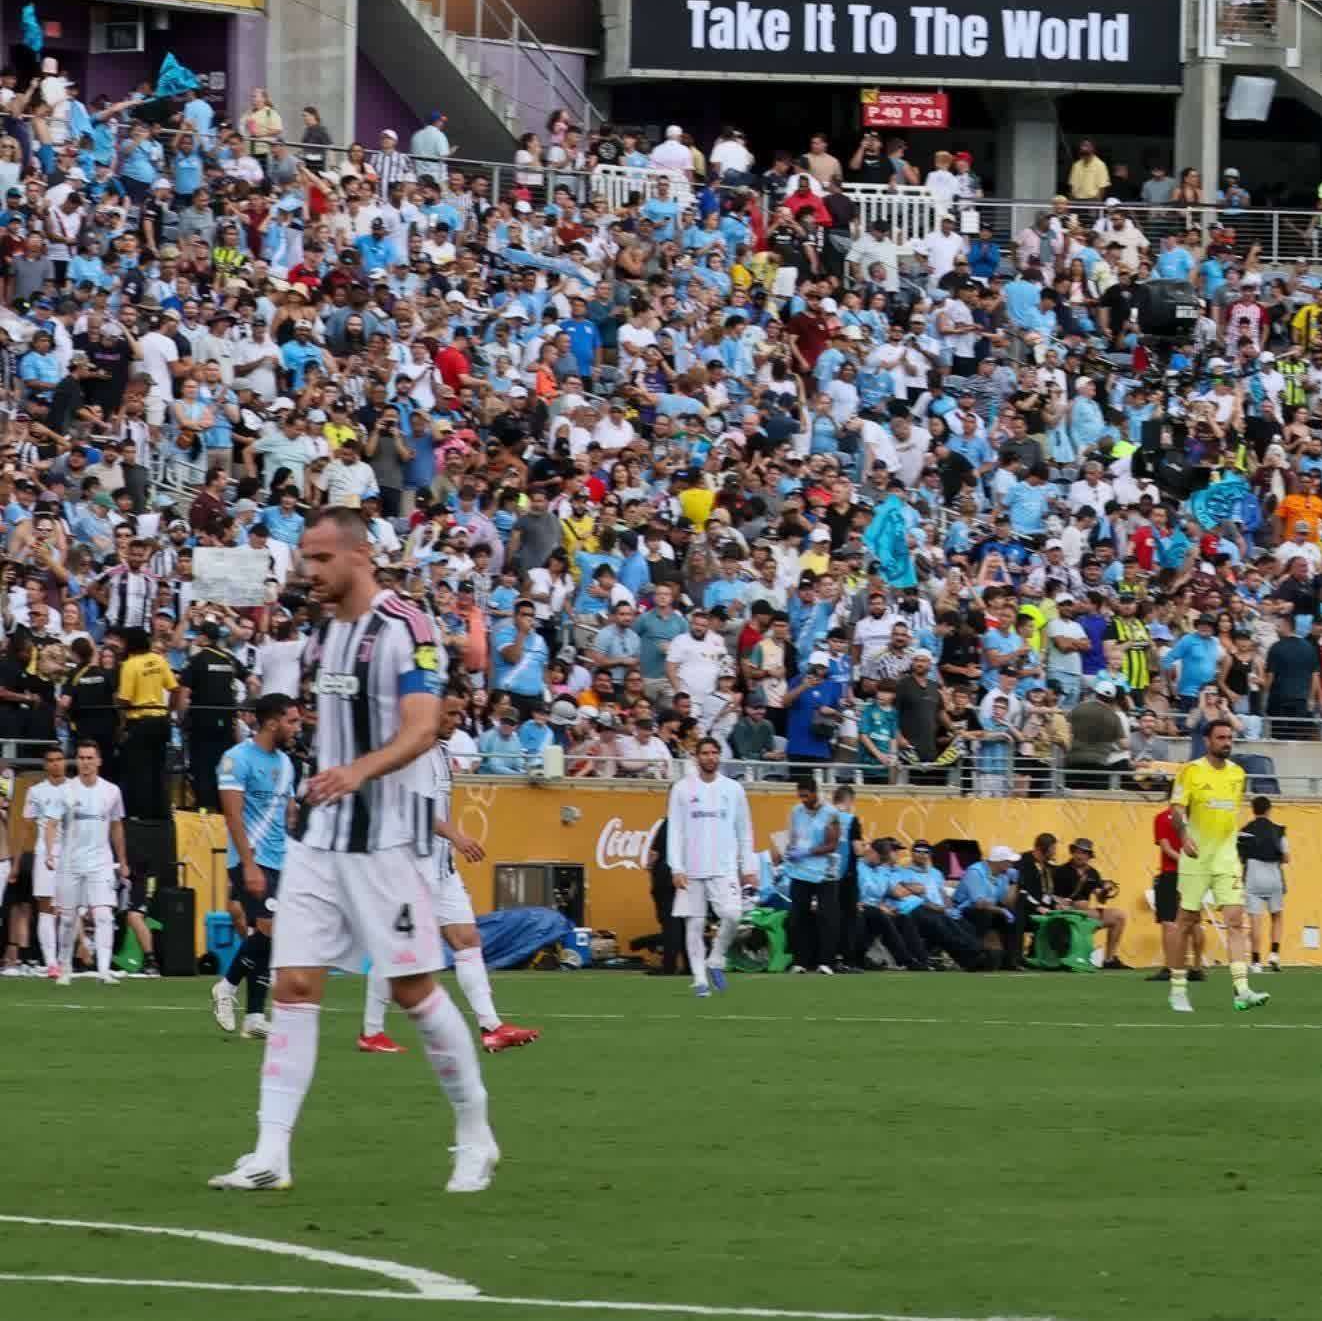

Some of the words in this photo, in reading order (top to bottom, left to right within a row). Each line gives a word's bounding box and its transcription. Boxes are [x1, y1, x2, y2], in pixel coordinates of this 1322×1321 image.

[804, 2, 836, 53] It
[847, 3, 898, 55] To
[909, 5, 989, 57] The
[1001, 9, 1130, 62] World
[394, 903, 415, 938] 4
